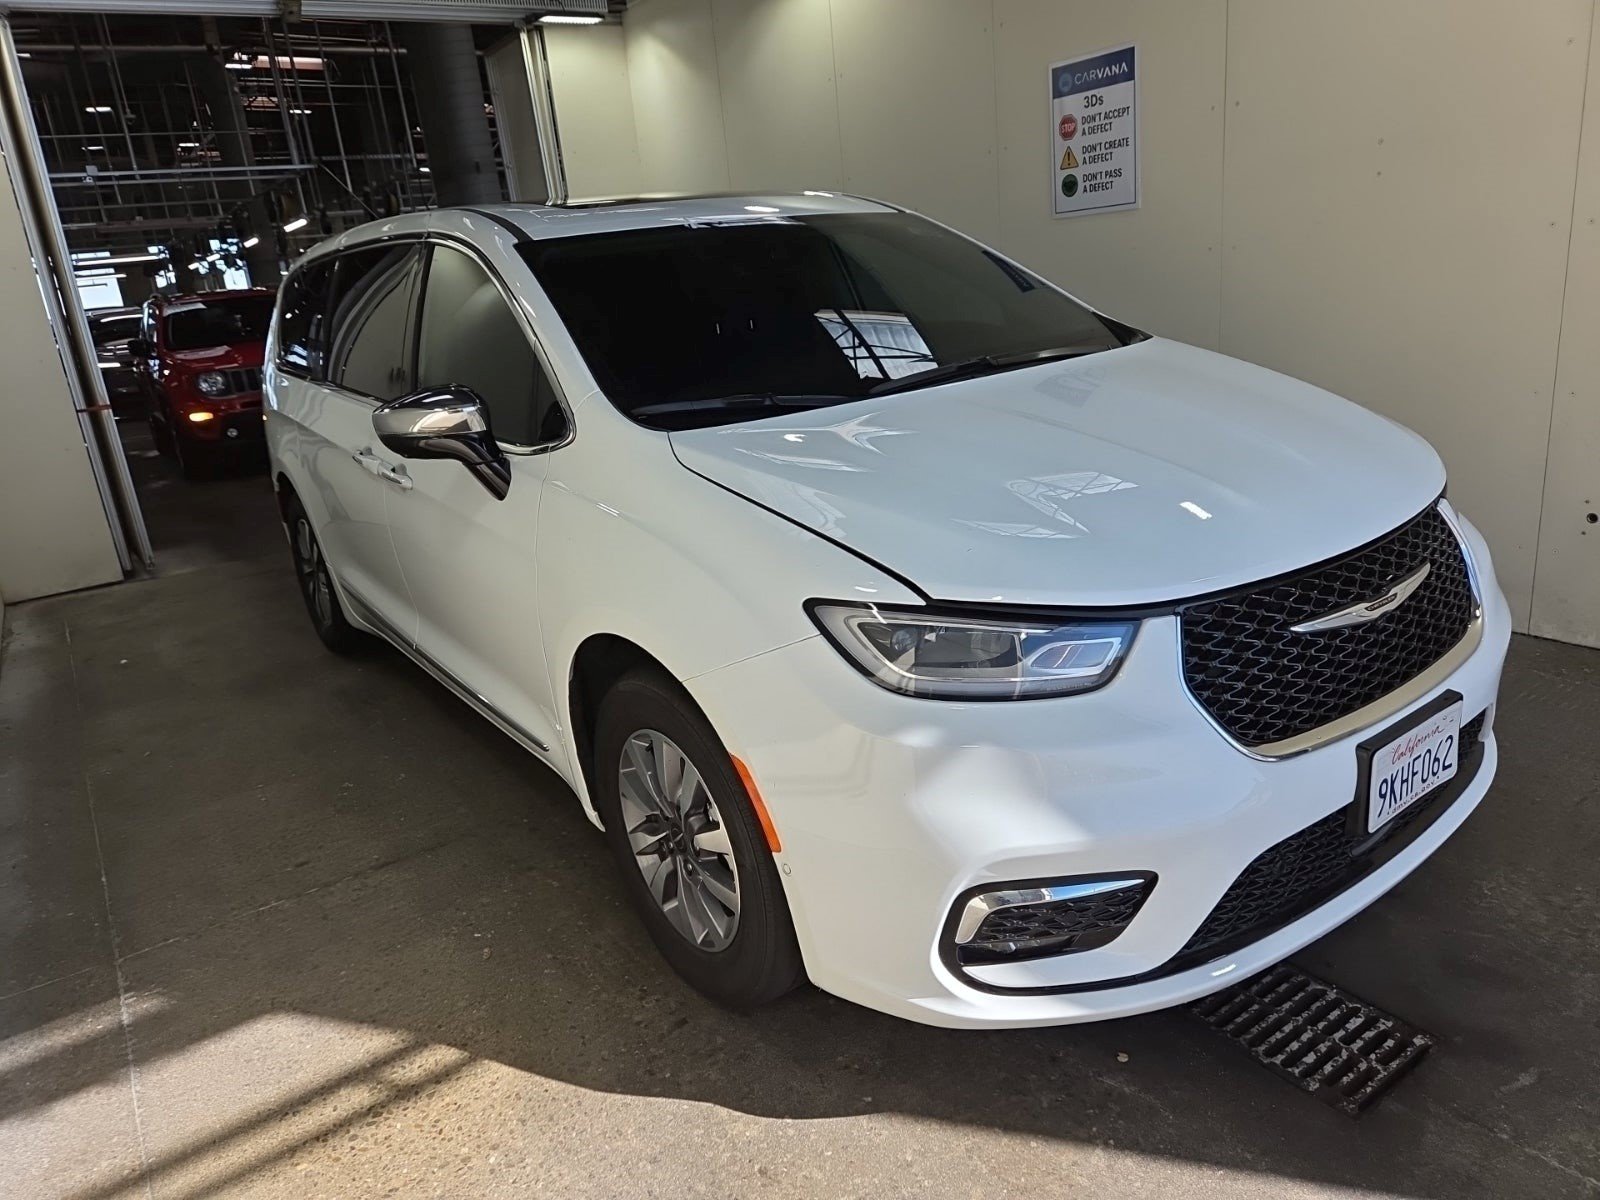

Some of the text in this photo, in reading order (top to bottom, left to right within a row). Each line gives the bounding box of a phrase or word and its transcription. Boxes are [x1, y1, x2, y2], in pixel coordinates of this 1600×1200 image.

[1074, 61, 1128, 85] CARVANA
[1084, 94, 1104, 109] 3Ds
[1081, 106, 1131, 125] DON'T ACCEPT
[1061, 123, 1076, 133] STOP
[1081, 122, 1113, 137] A DEFECT
[1082, 137, 1130, 155] DON'T CREATE
[1082, 151, 1113, 166] A DEFECT
[1082, 168, 1123, 183] DON'T PASS
[1083, 180, 1114, 194] A DEFECT
[1391, 725, 1444, 765] California
[1377, 734, 1454, 818] 9KHF062
